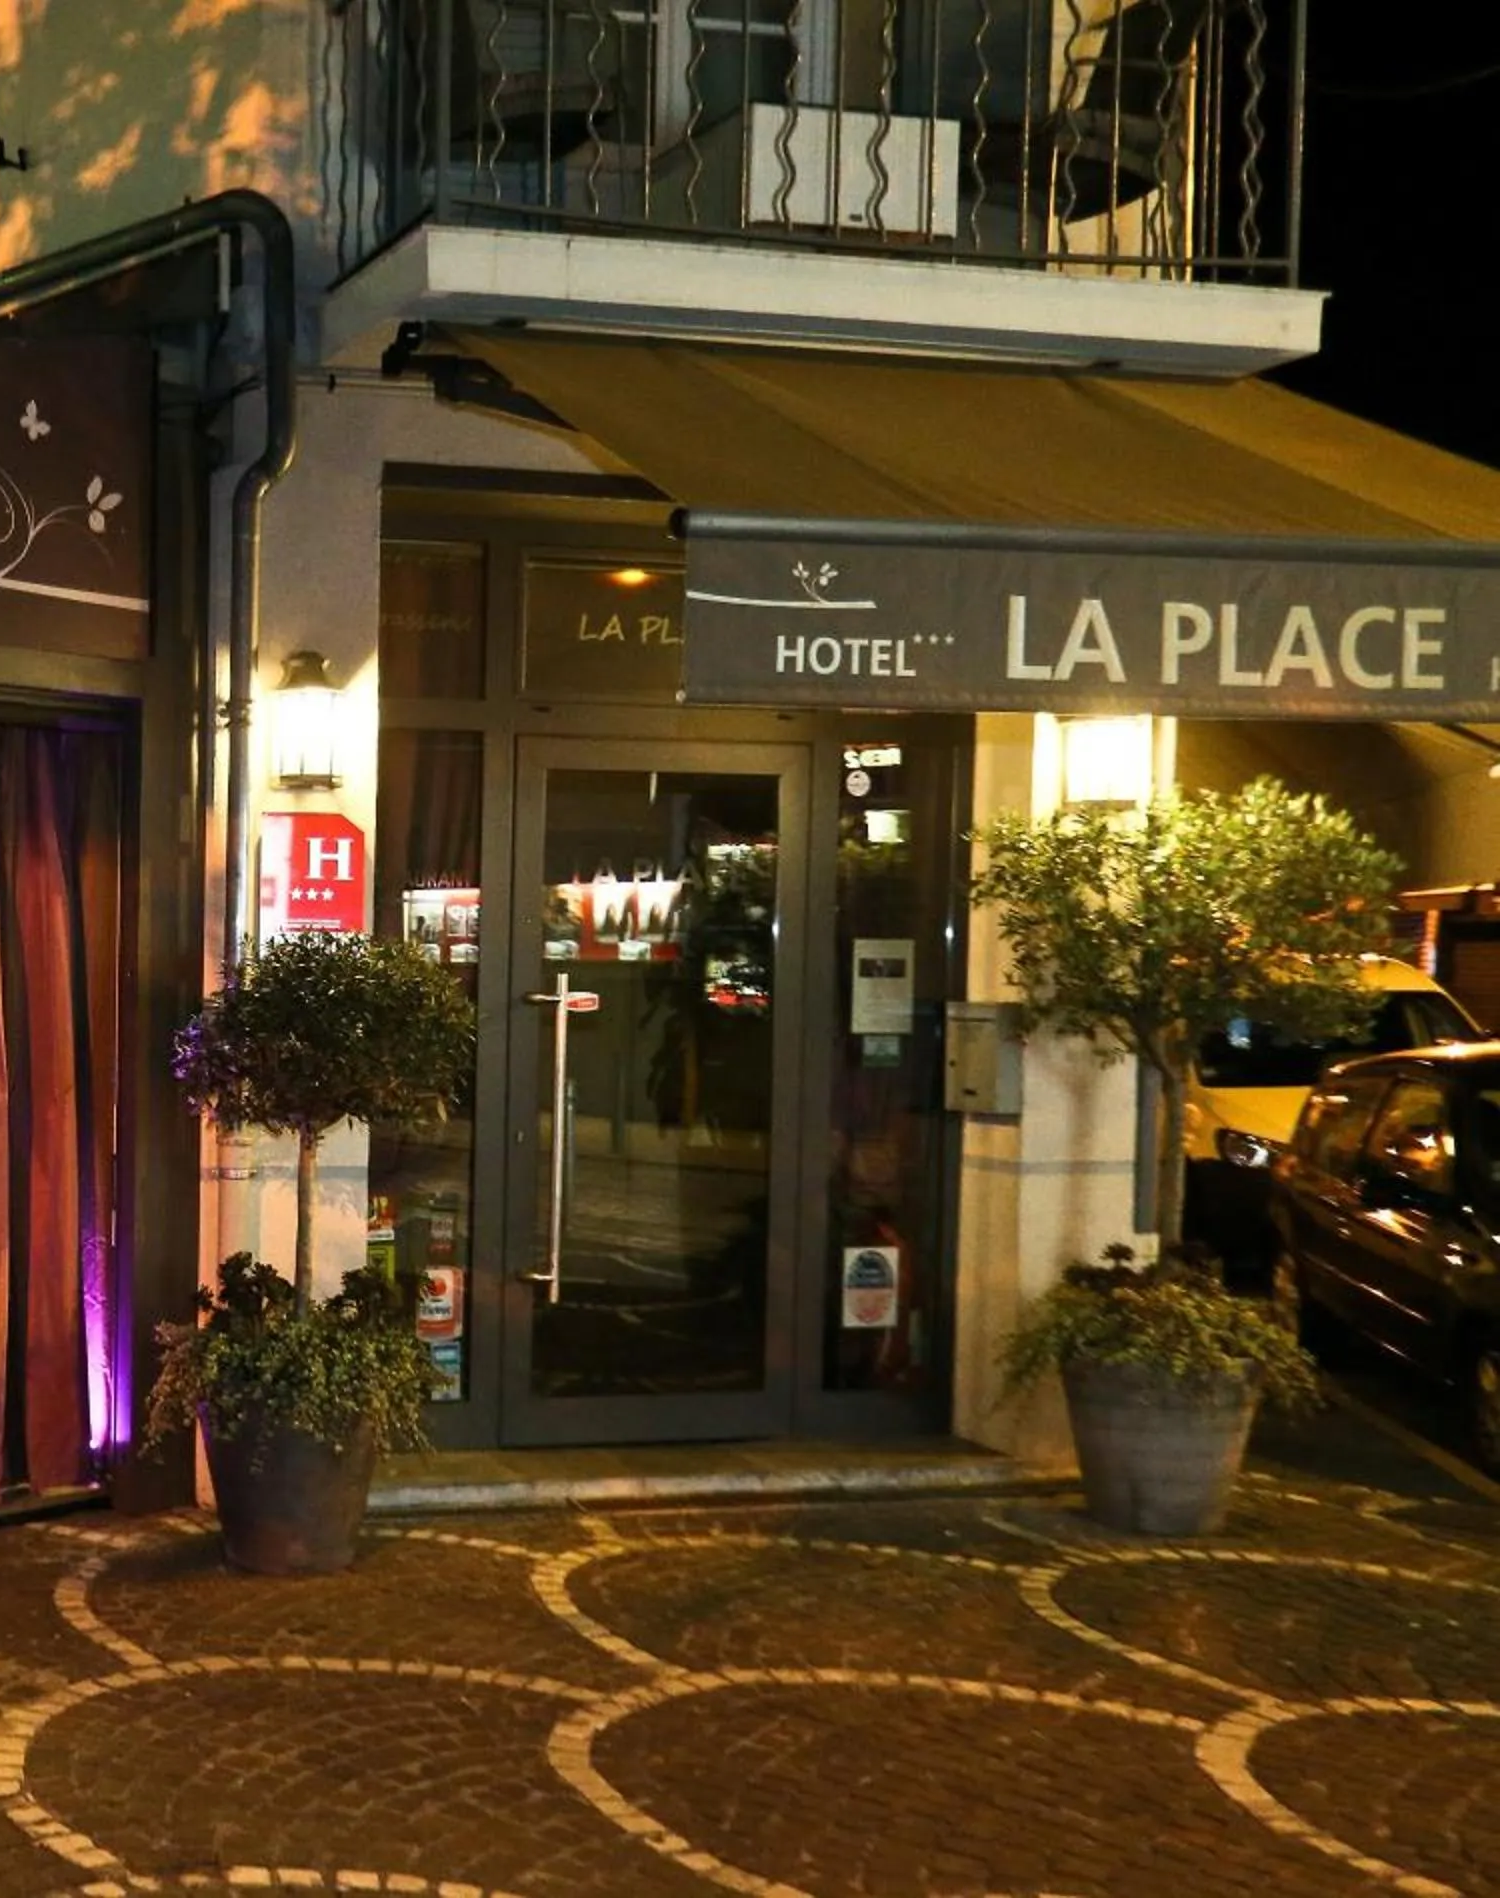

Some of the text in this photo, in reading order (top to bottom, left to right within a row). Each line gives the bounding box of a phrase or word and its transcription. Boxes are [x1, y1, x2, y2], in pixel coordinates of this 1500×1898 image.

[578, 613, 686, 645] LA PL
[1006, 595, 1446, 690] LA PLACE
[775, 635, 917, 677] HOTEL
[306, 836, 354, 881] H
